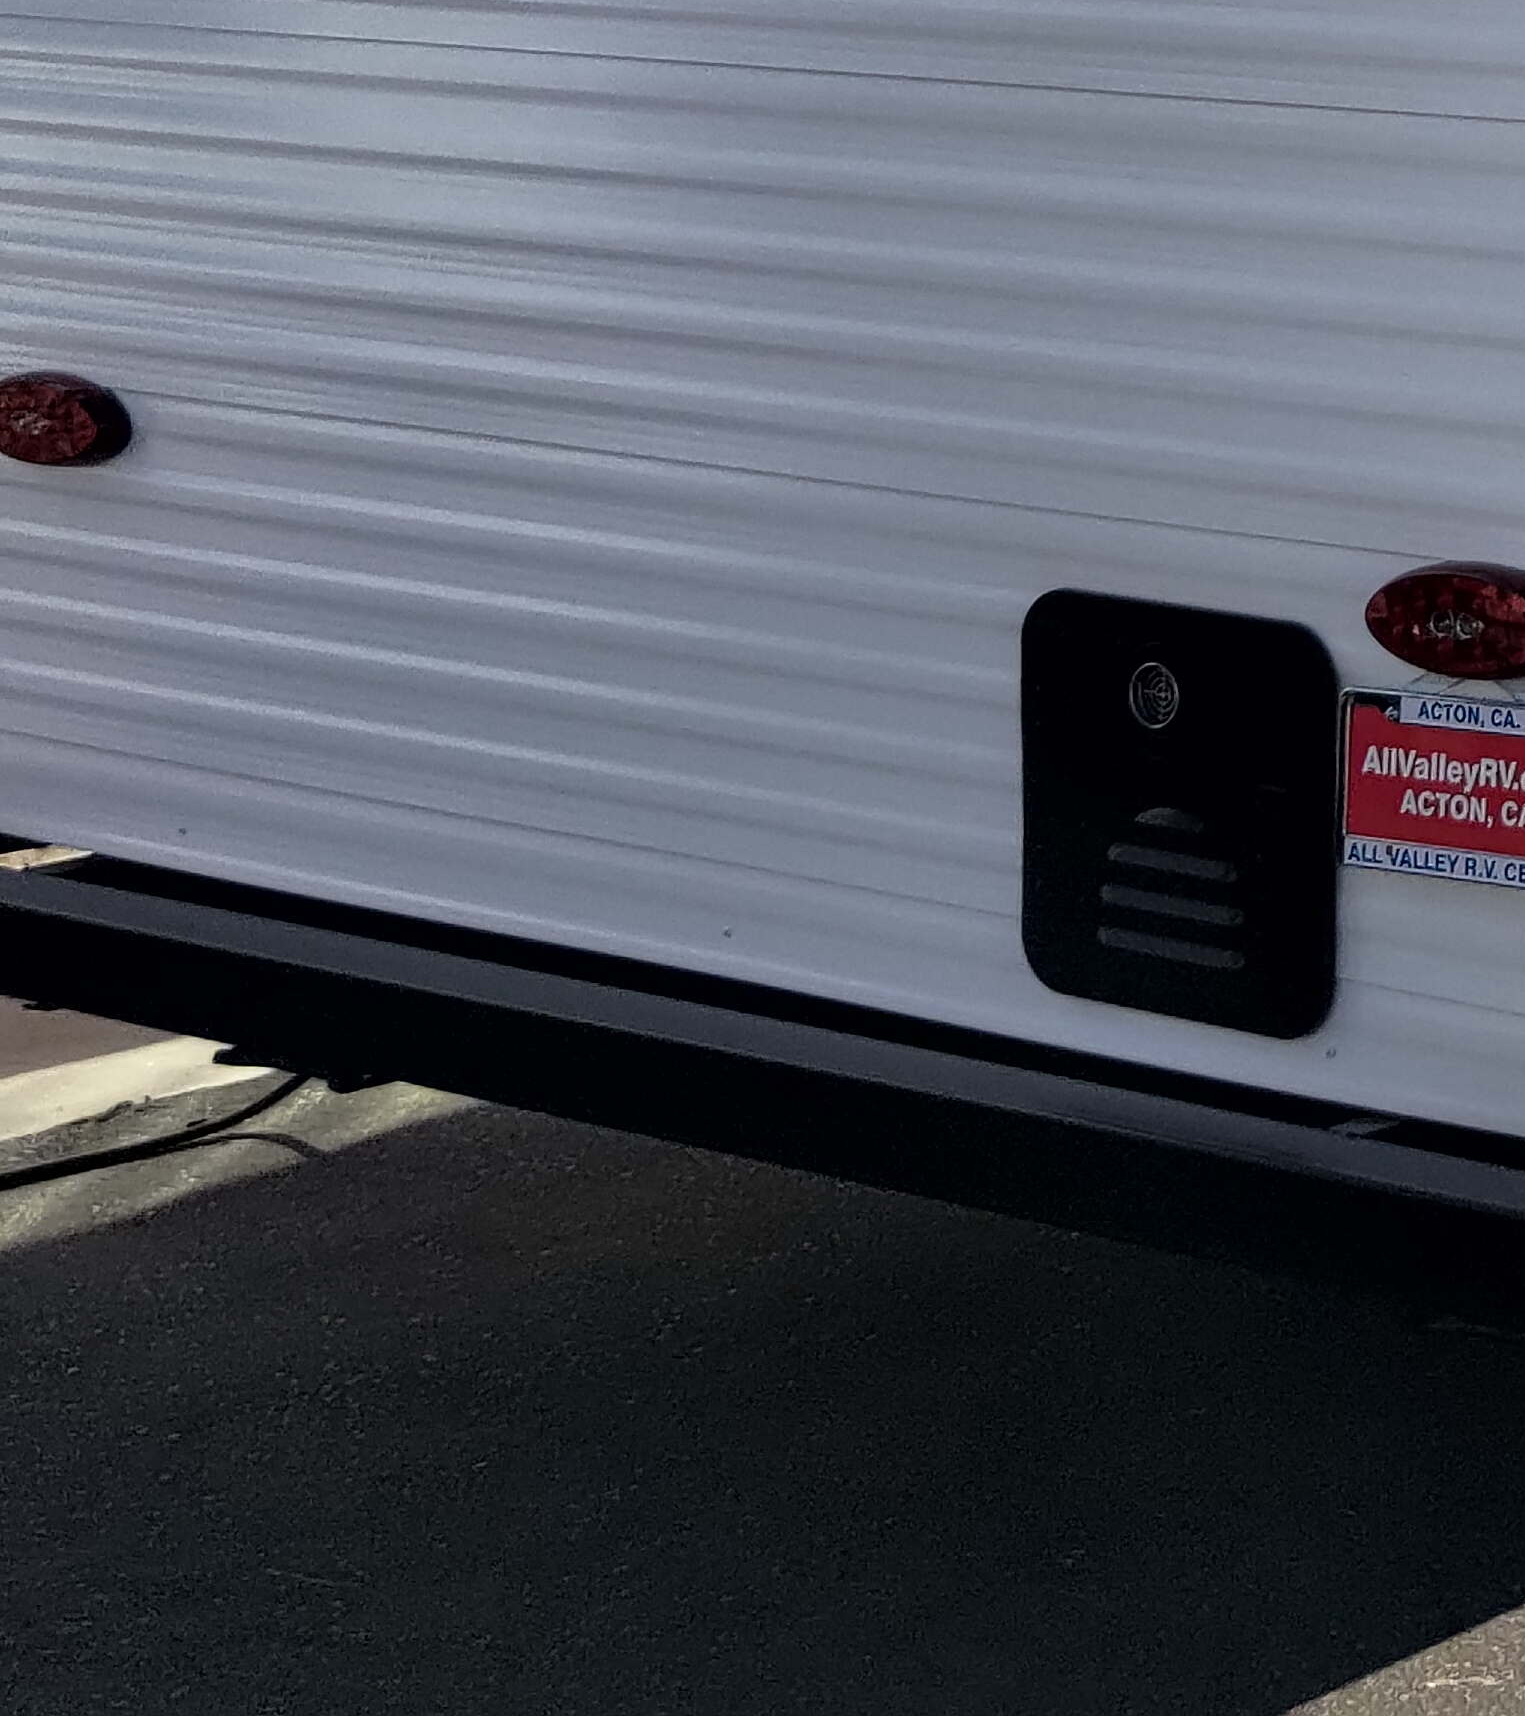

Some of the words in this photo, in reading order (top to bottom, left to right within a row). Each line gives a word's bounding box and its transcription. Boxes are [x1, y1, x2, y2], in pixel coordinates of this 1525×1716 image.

[1418, 700, 1485, 729] ACTON,
[1490, 708, 1521, 730] CA.
[1400, 788, 1494, 829] ACTON,
[1347, 841, 1384, 864] ALL
[1388, 846, 1459, 874] VALLEY
[1464, 857, 1499, 880] R.V.
